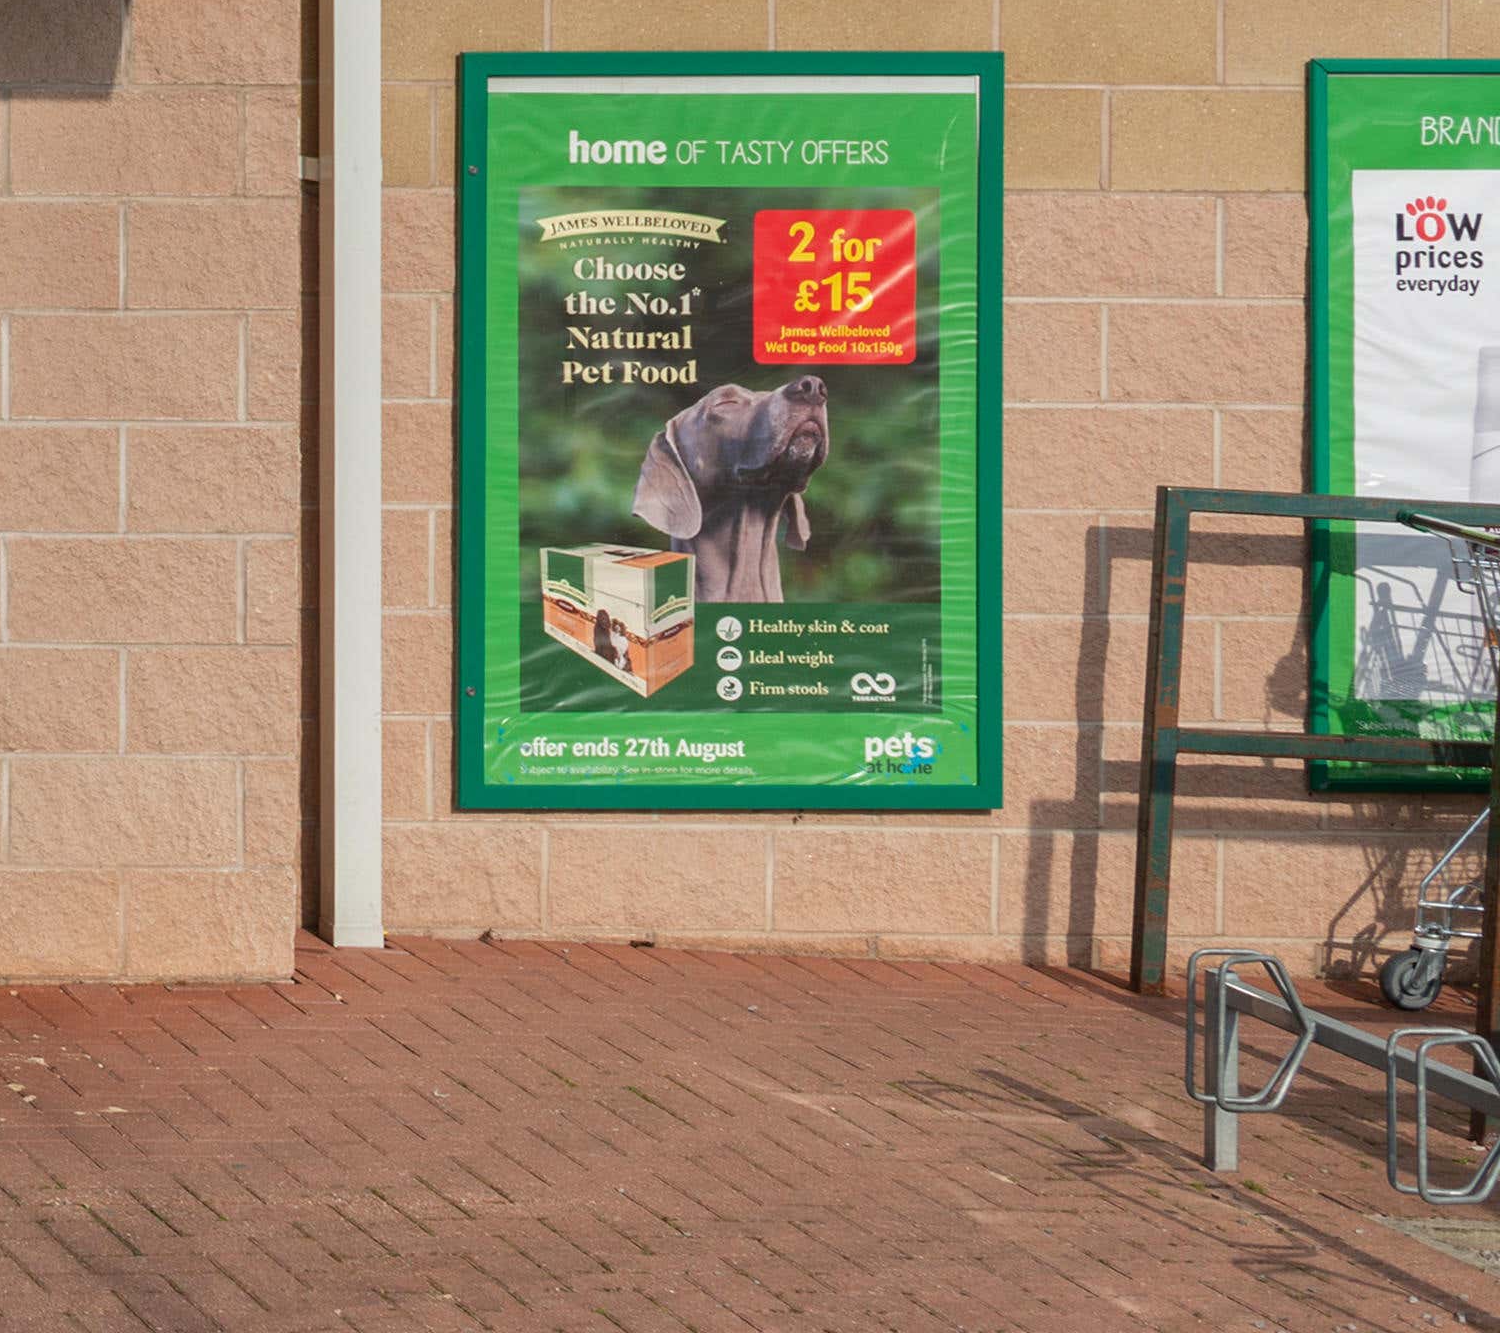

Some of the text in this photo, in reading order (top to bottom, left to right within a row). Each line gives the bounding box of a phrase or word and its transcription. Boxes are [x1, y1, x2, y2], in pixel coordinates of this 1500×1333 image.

[569, 129, 889, 165] home OF TASTY OFFERS
[550, 216, 712, 237] JAMES WELLBELOVED
[1395, 212, 1484, 243] LOW
[559, 236, 701, 250] NATURALLY HEALTHY
[787, 221, 883, 262] 2 for
[573, 256, 686, 281] Choose
[1395, 245, 1484, 276] prices
[794, 271, 874, 312] £15
[1396, 274, 1481, 297] everyday
[563, 290, 617, 315] the
[565, 324, 693, 350] Natural
[779, 324, 891, 340] James Wellbeloved
[765, 341, 904, 357] Wet Dog Food 10x150g
[561, 359, 698, 384] Pet Food
[749, 618, 890, 637] Healthy skin & coat
[749, 649, 835, 669] Ideal weight
[749, 681, 829, 696] Firm stools
[520, 736, 746, 763] offer ends 27th August
[864, 731, 935, 763] pets
[866, 760, 883, 774] at
